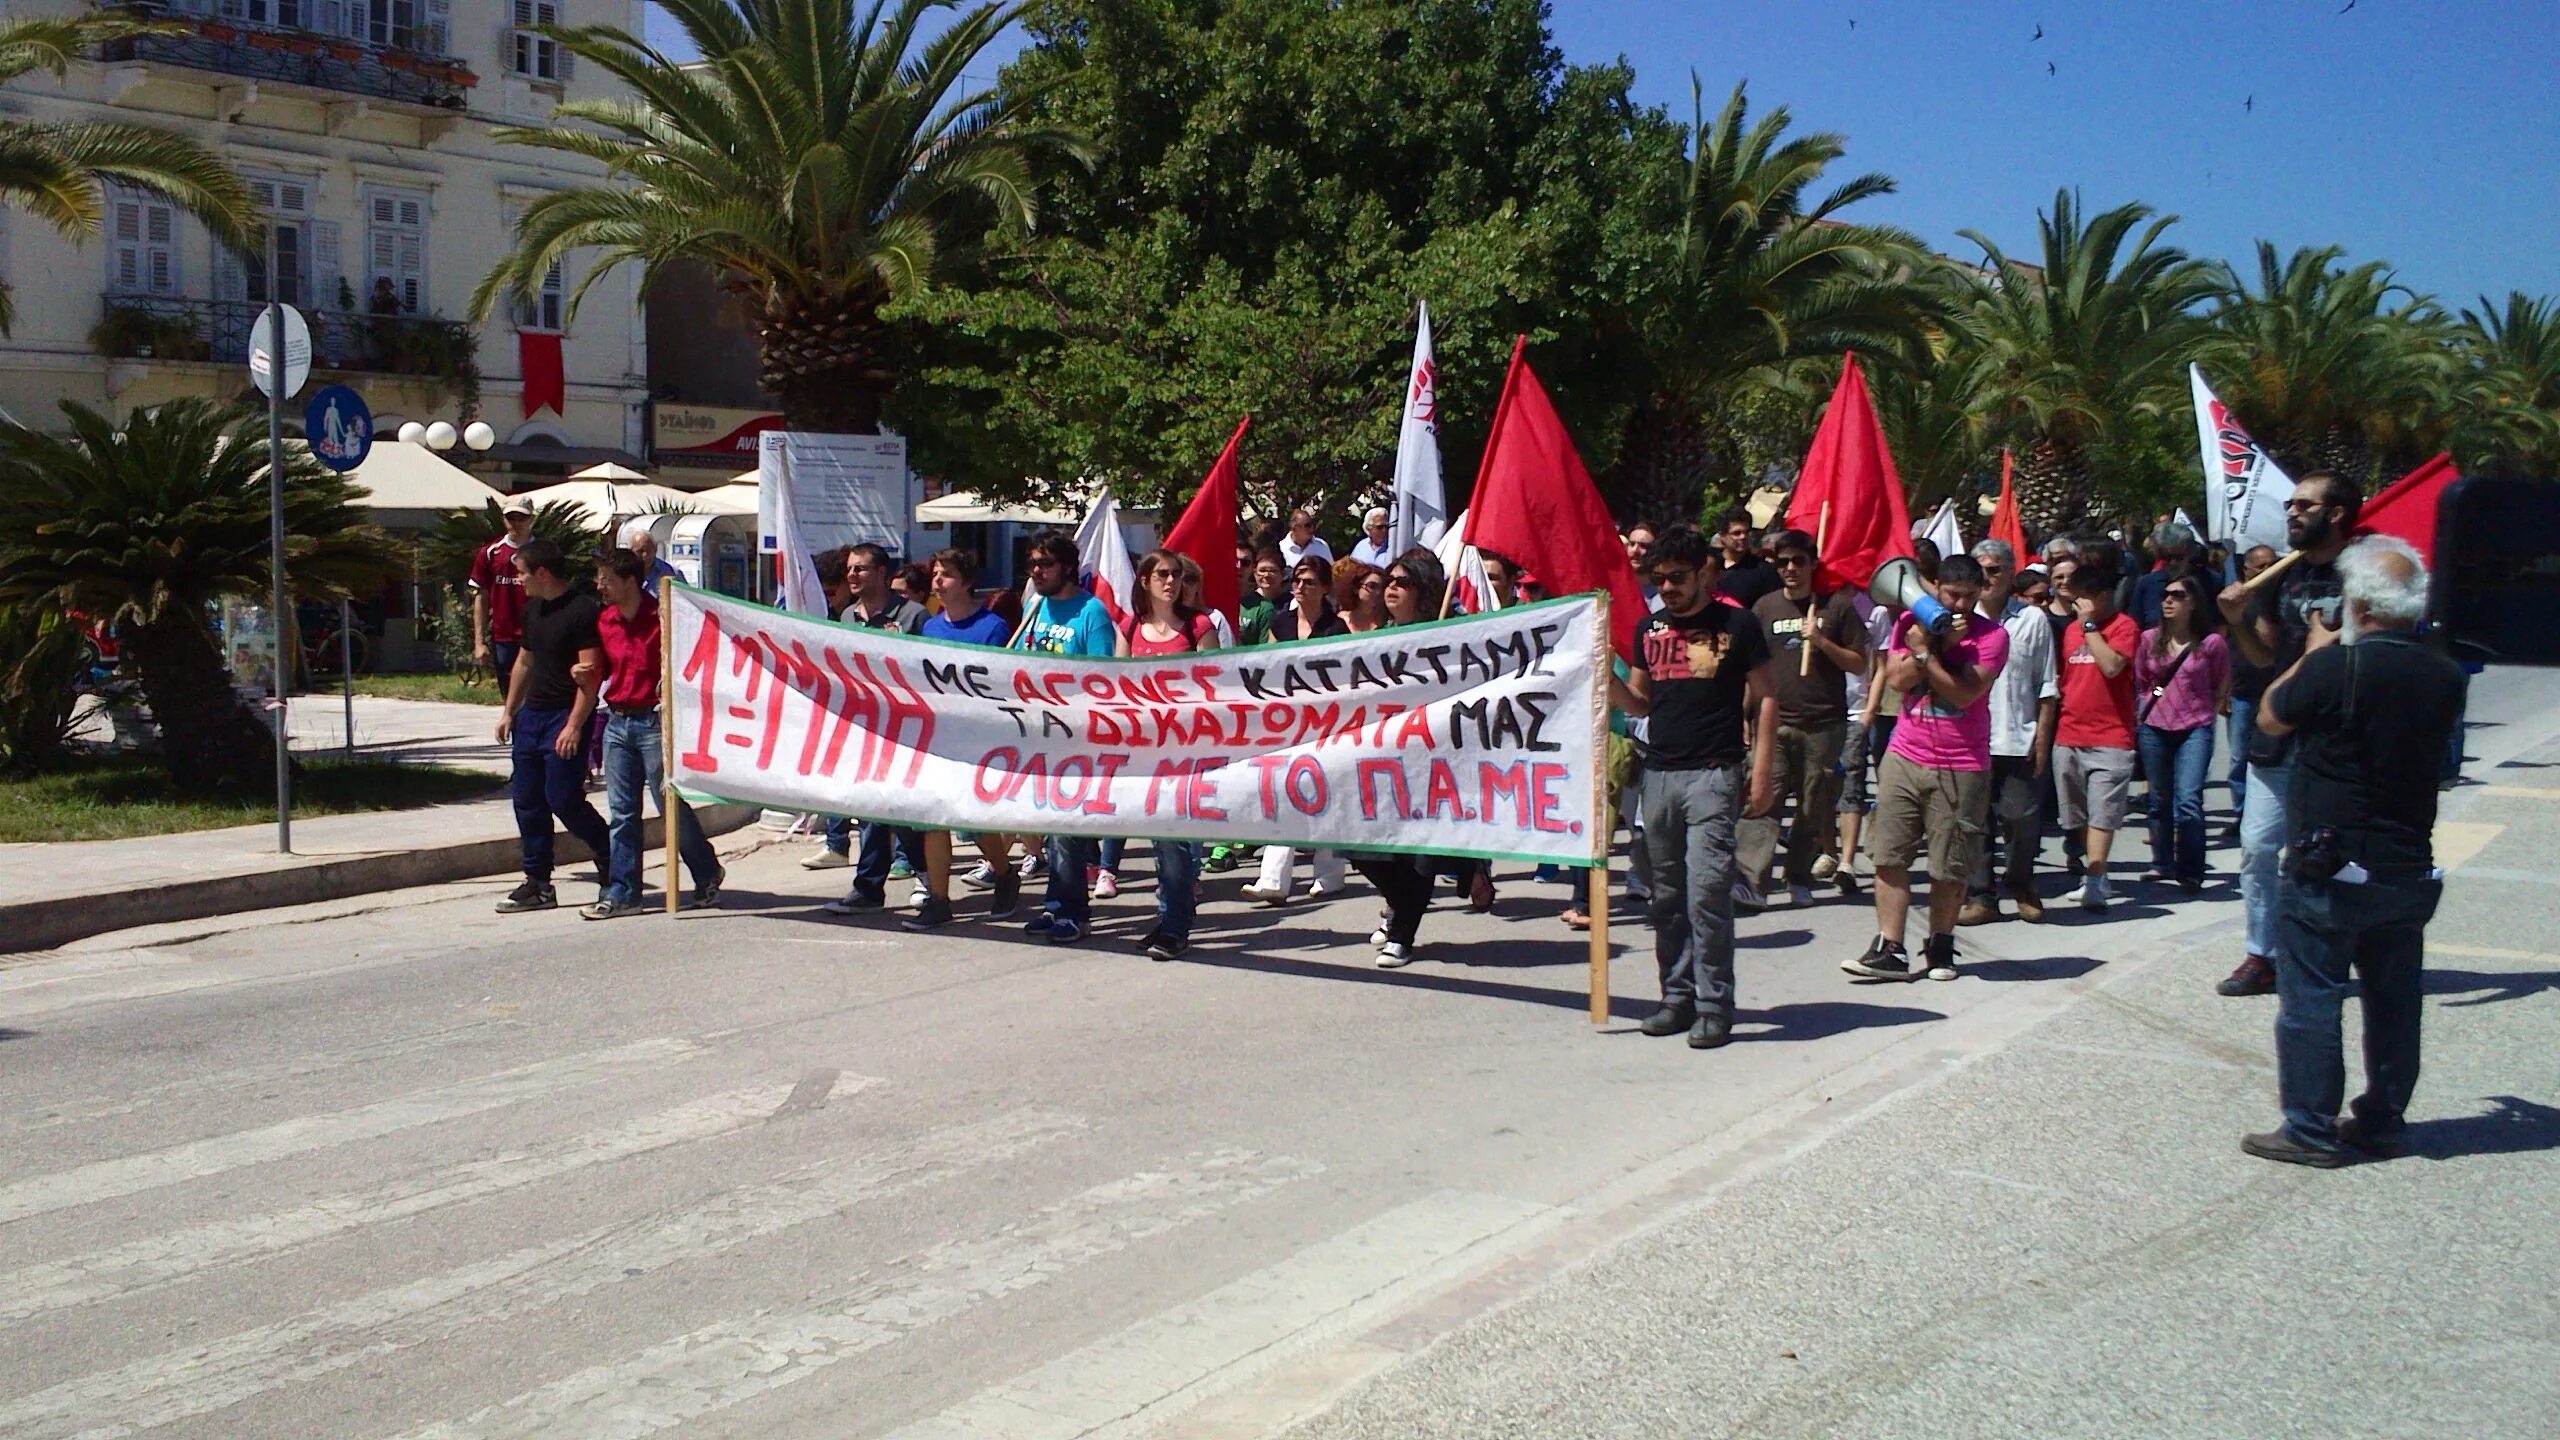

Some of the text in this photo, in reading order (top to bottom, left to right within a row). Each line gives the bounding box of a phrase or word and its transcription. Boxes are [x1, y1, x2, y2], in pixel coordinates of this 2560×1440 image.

[736, 436, 760, 451] AVI
[922, 658, 1006, 702] ΜΕ
[1238, 624, 1558, 700] ΚΑΤΑΚΤΑΜΕ
[2068, 653, 2096, 664] adida
[998, 692, 1561, 751] ΤΑ ΔΙΚΑΙΩΜΑΤΑ ΜΑΣ
[973, 745, 1584, 836] ΟΛΟΙ ΜΕ ΤΟ Π.Α.ΜΕ.
